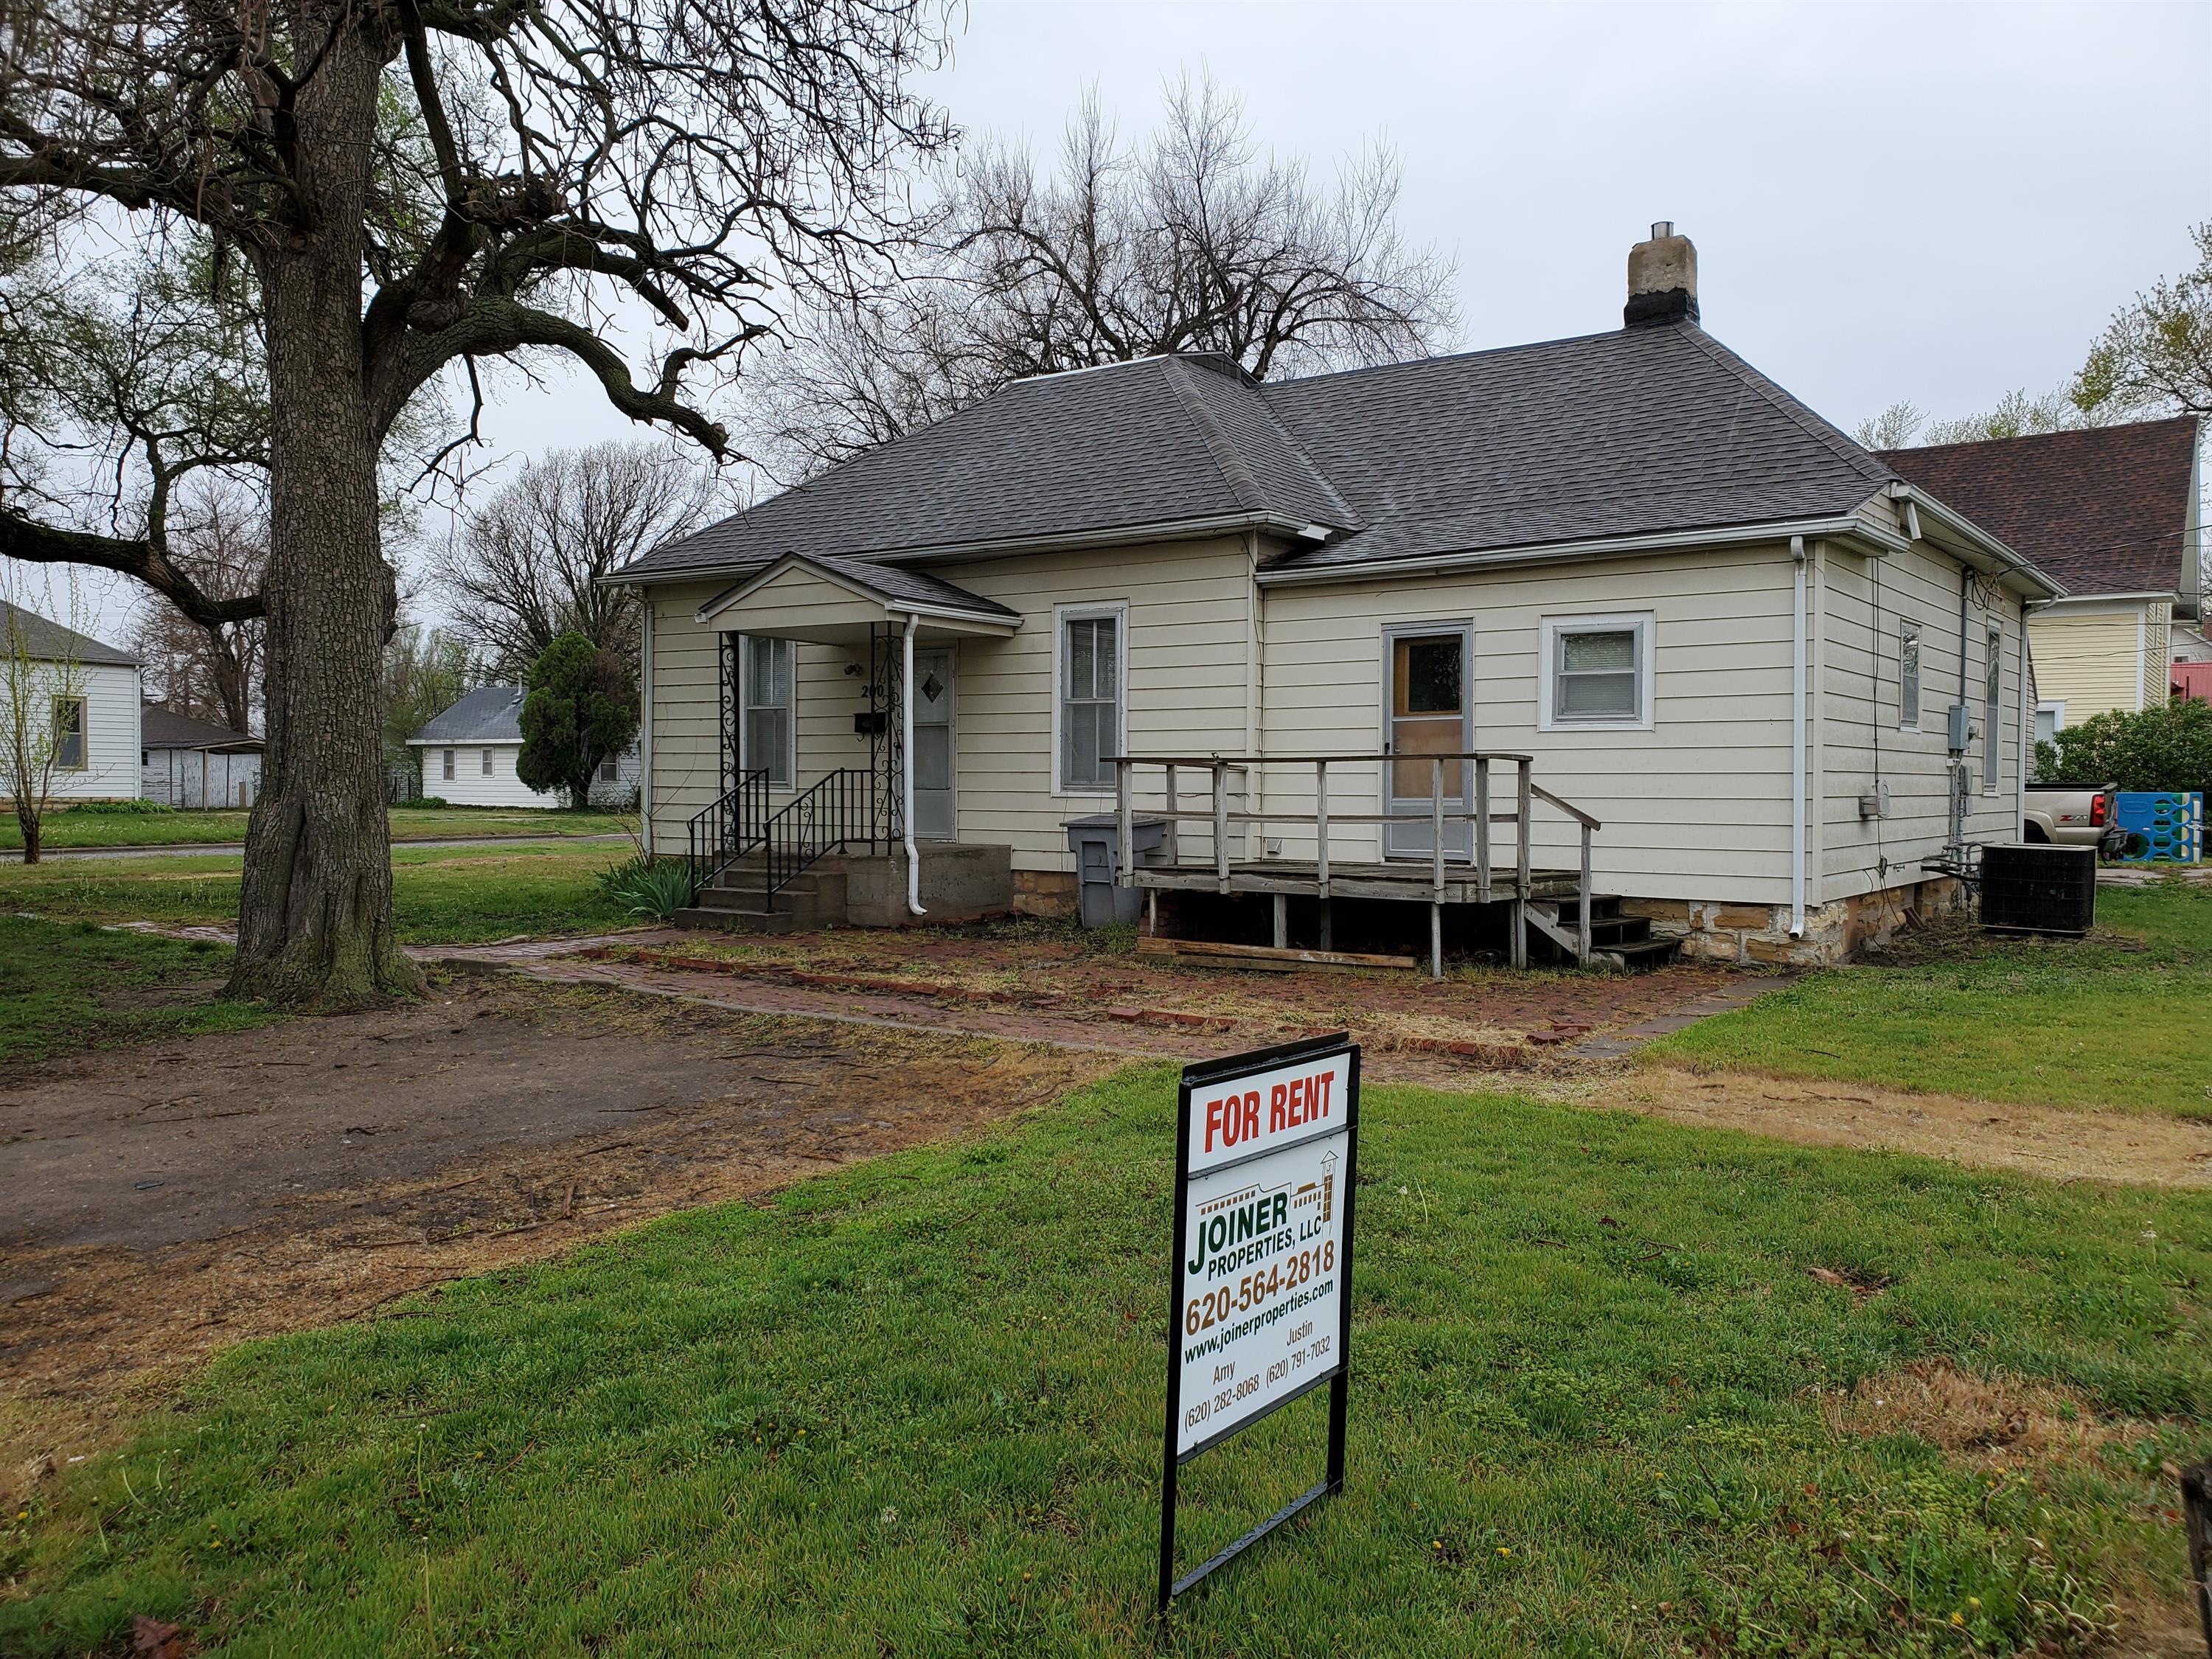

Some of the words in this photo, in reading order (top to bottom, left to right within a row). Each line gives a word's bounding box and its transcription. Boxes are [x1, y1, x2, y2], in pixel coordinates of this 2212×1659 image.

[1204, 1090, 1260, 1153] FOR
[1269, 1070, 1335, 1134] RENT
[1188, 1192, 1288, 1275] JOINER
[1208, 1227, 1295, 1281] PROPERTIES,
[1299, 1215, 1322, 1242] LLC
[1186, 1239, 1335, 1336] 620-564-2818
[1185, 1279, 1333, 1364] www.joinerproperties.com
[1287, 1320, 1312, 1346] Justin
[1213, 1361, 1236, 1385] Amy
[1266, 1358, 1289, 1388] (620)
[1292, 1335, 1330, 1371] 791-7032
[1185, 1400, 1211, 1433] (620)
[1214, 1374, 1259, 1414] 282-8068
